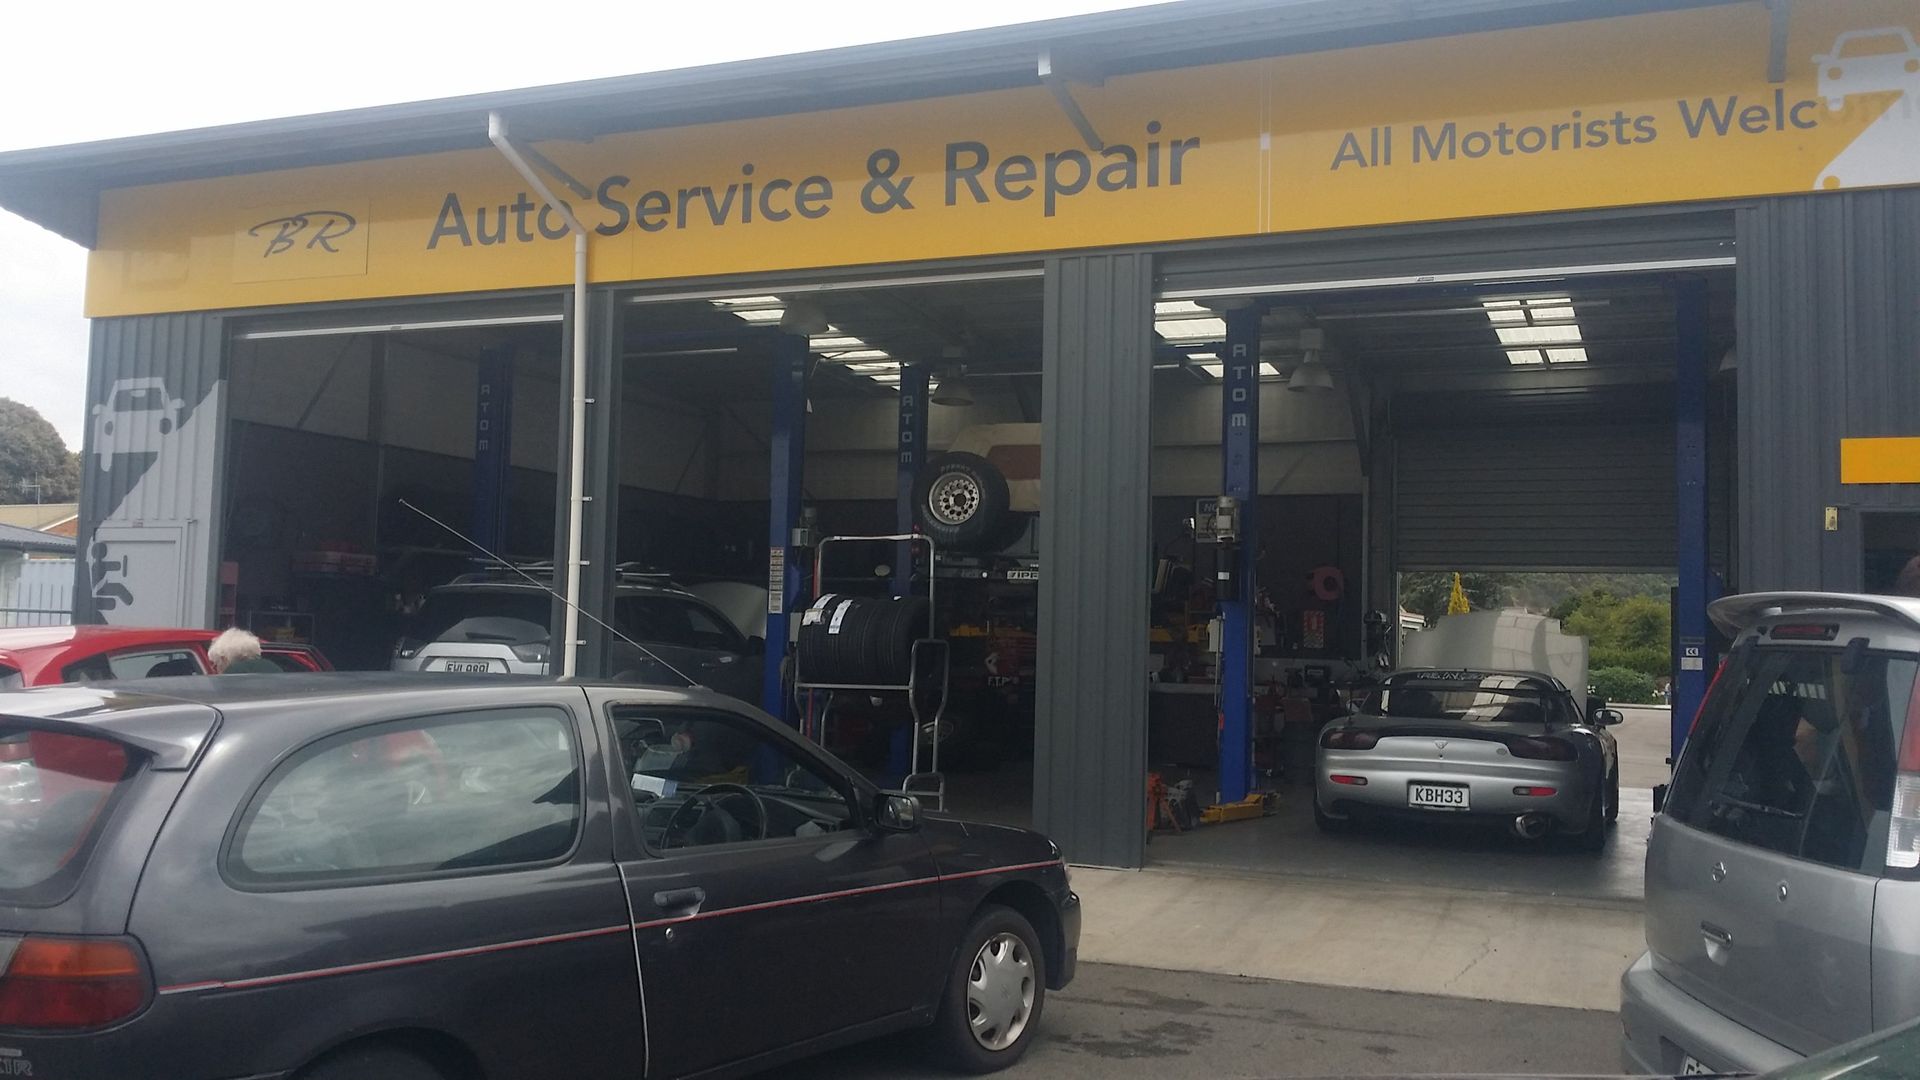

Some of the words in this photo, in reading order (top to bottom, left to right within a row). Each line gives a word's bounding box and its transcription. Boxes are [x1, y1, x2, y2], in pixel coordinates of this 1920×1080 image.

[1330, 127, 1392, 171] All
[1411, 110, 1658, 163] Motorists
[426, 192, 575, 250] Auto
[595, 163, 833, 236] Service
[860, 148, 915, 214] &
[944, 120, 1201, 218] Repair
[479, 384, 490, 451] ATOM
[1231, 343, 1248, 427] ATOM
[901, 395, 913, 463] ATOM
[1415, 787, 1464, 804] KBH33
